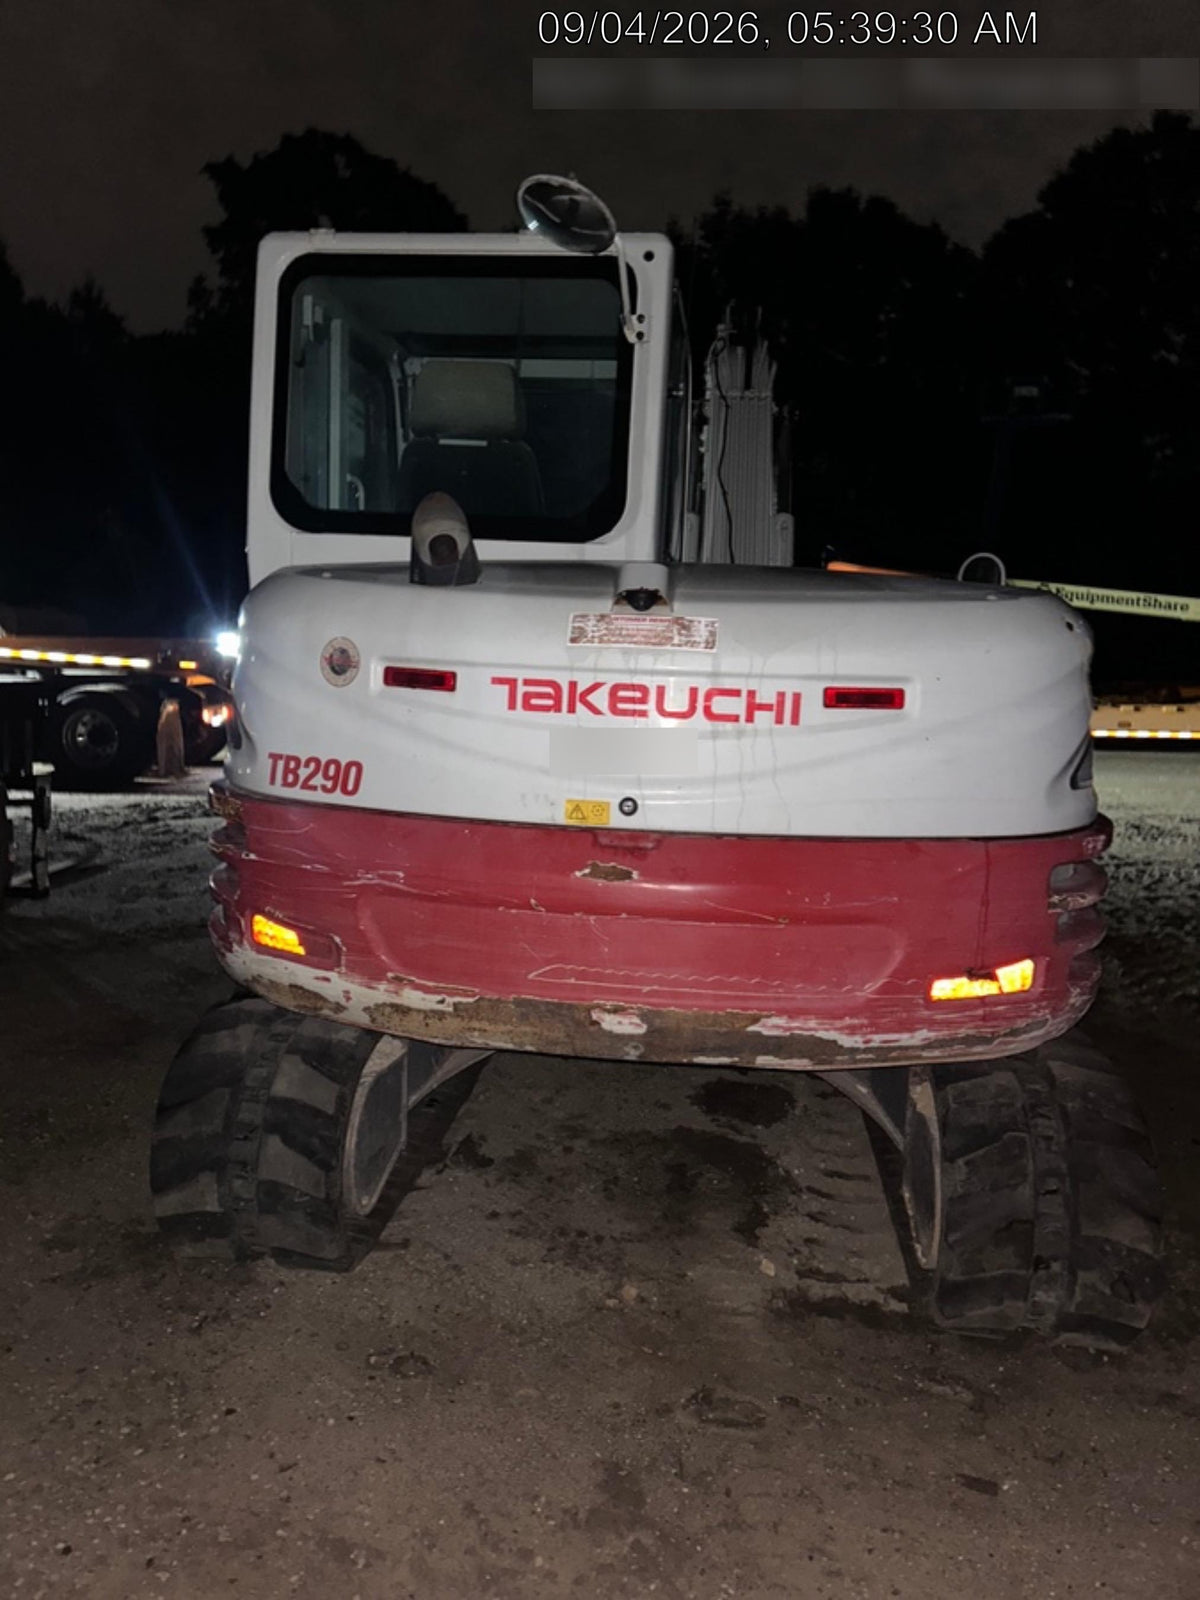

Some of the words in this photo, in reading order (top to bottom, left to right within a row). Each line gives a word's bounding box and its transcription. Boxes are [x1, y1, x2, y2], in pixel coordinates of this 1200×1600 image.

[1056, 586, 1190, 612] EquipmentShare
[490, 676, 803, 726] TAKEUCHI
[267, 752, 363, 797] TB290
